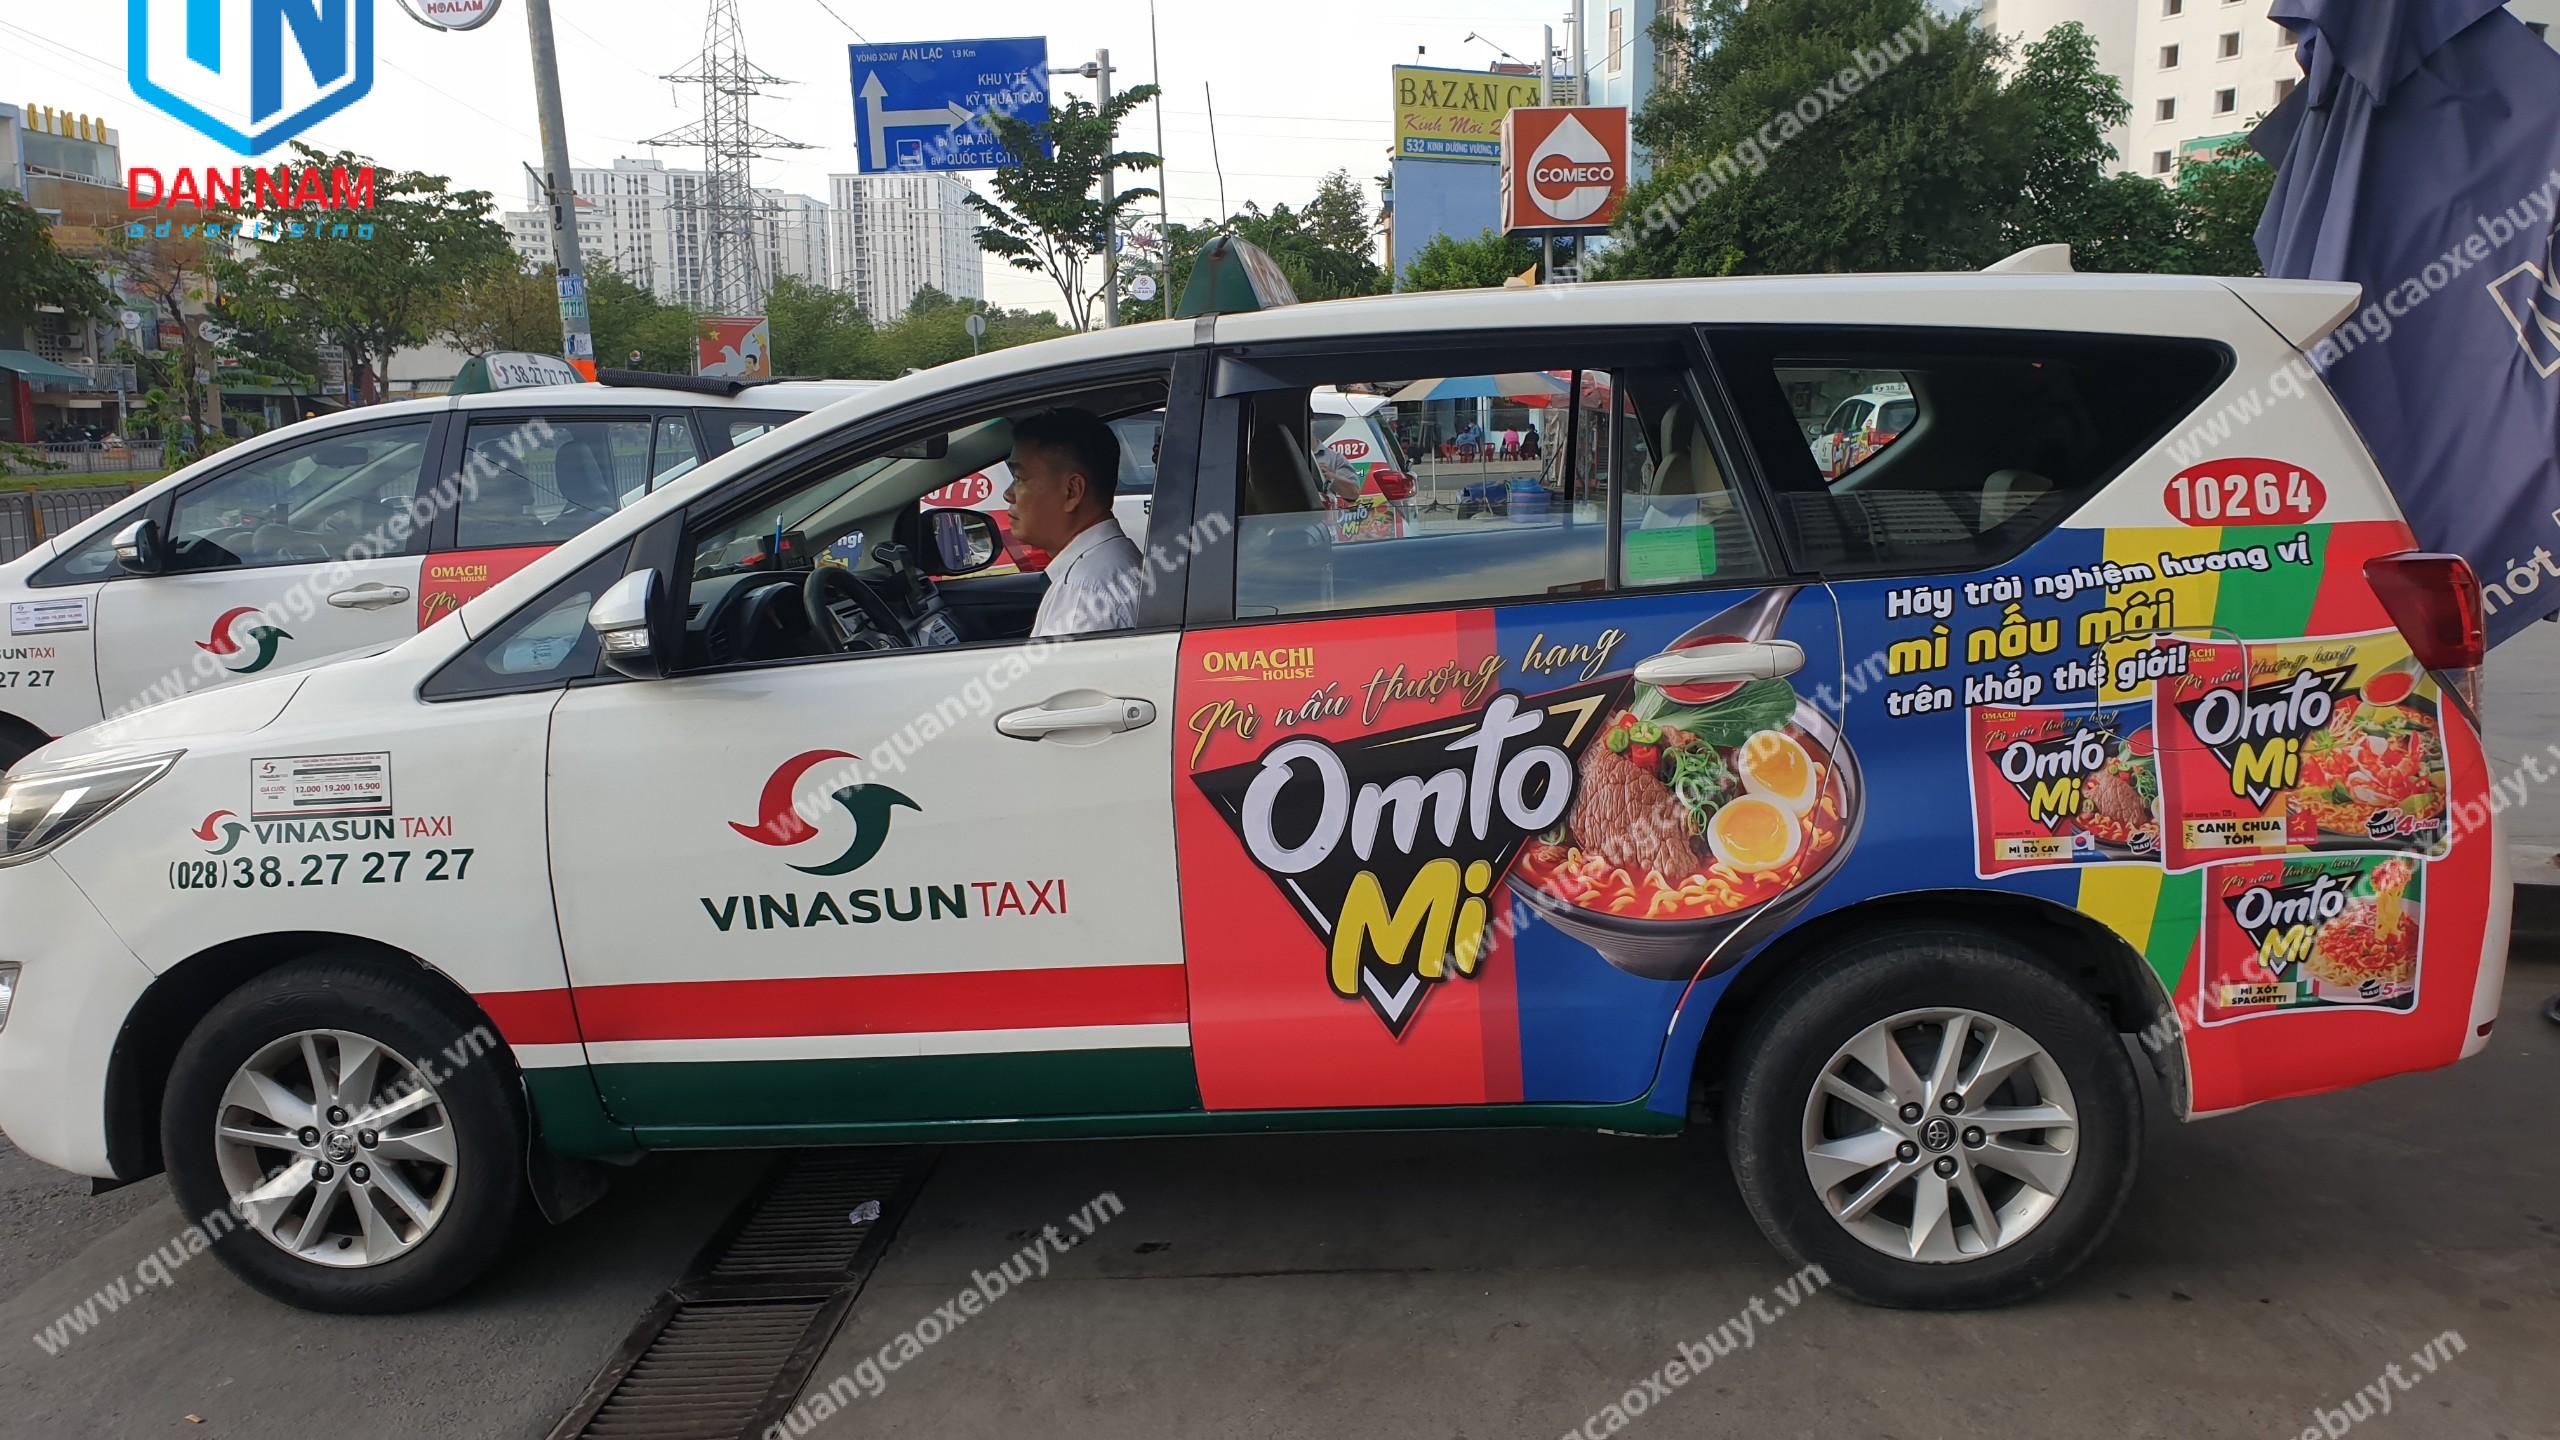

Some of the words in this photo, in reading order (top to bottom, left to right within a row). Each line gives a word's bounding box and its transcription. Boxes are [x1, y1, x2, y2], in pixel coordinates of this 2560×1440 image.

[856, 53, 878, 63] VÒNG
[902, 49, 918, 61] AN
[921, 47, 943, 63] LẠC
[952, 50, 961, 58] 1.9
[962, 49, 976, 58] Km
[978, 73, 1001, 86] KHU
[1004, 72, 1014, 84] Y
[1013, 66, 1029, 85] TẾ
[965, 91, 980, 107] KỸ
[982, 90, 1019, 106] THUẬT
[1021, 92, 1044, 104] CAO
[1400, 77, 1499, 112] BAZAN
[956, 134, 974, 146] GIA
[976, 133, 993, 145] AN
[1406, 138, 1425, 153] 532
[1427, 141, 1443, 152] KINH
[946, 149, 977, 165] QUỐC
[979, 147, 993, 164] TẾ
[1535, 167, 1615, 183] COMECO
[510, 364, 544, 386] 38.27
[544, 368, 557, 385] 27
[559, 370, 574, 385] 27
[921, 477, 990, 499] 773
[2171, 471, 2313, 520] 10264
[431, 565, 487, 578] OMACHI
[460, 575, 487, 583] HOUSE
[1887, 586, 1953, 619] Hãy
[2034, 560, 2153, 604] nghiệm
[2161, 545, 2270, 578] hương
[2277, 533, 2309, 565] vị
[1887, 622, 1951, 676] mì
[1966, 601, 2060, 664] nấu
[2079, 588, 2176, 646] mới
[28, 648, 55, 658] TAXI
[1202, 647, 1315, 674] OMACHI
[2189, 648, 2216, 658] ACHI
[28, 670, 55, 687] 27
[1262, 667, 1315, 681] HOUSE
[1886, 686, 1954, 718] trên
[1963, 664, 2043, 706] khắp
[2053, 650, 2109, 692] thế
[2118, 644, 2189, 690] giới!
[1188, 698, 1261, 770] Mì
[1273, 681, 1352, 728] nấu
[1359, 652, 1508, 727] thượng
[1520, 628, 1627, 683] hạng
[2192, 667, 2332, 745] Omto
[1981, 711, 2017, 721] OMACHI
[2001, 727, 2105, 783] Omto
[2231, 737, 2299, 796] Mi
[295, 785, 321, 793] 12.000
[324, 783, 351, 792] 19.200
[353, 782, 380, 790] 16.900
[1241, 692, 1573, 874] Omto
[2030, 777, 2081, 821] Mi
[254, 817, 395, 845] VINASUN
[400, 815, 453, 838] TAXI
[2196, 823, 2236, 833] CANH
[2241, 820, 2282, 832] CHUA
[2396, 815, 2414, 835] 4
[2223, 832, 2254, 845] TÔM
[232, 853, 349, 888] 38.27
[361, 851, 411, 884] 27
[425, 848, 475, 881] 27
[699, 884, 968, 932] VINASUN
[971, 879, 1068, 917] TAXI
[2236, 874, 2344, 929] Omto
[1331, 857, 1492, 994] Mi
[2259, 923, 2317, 967] Mi
[2382, 982, 2394, 996] 5
[2231, 995, 2287, 1005] SPAGHETTI
